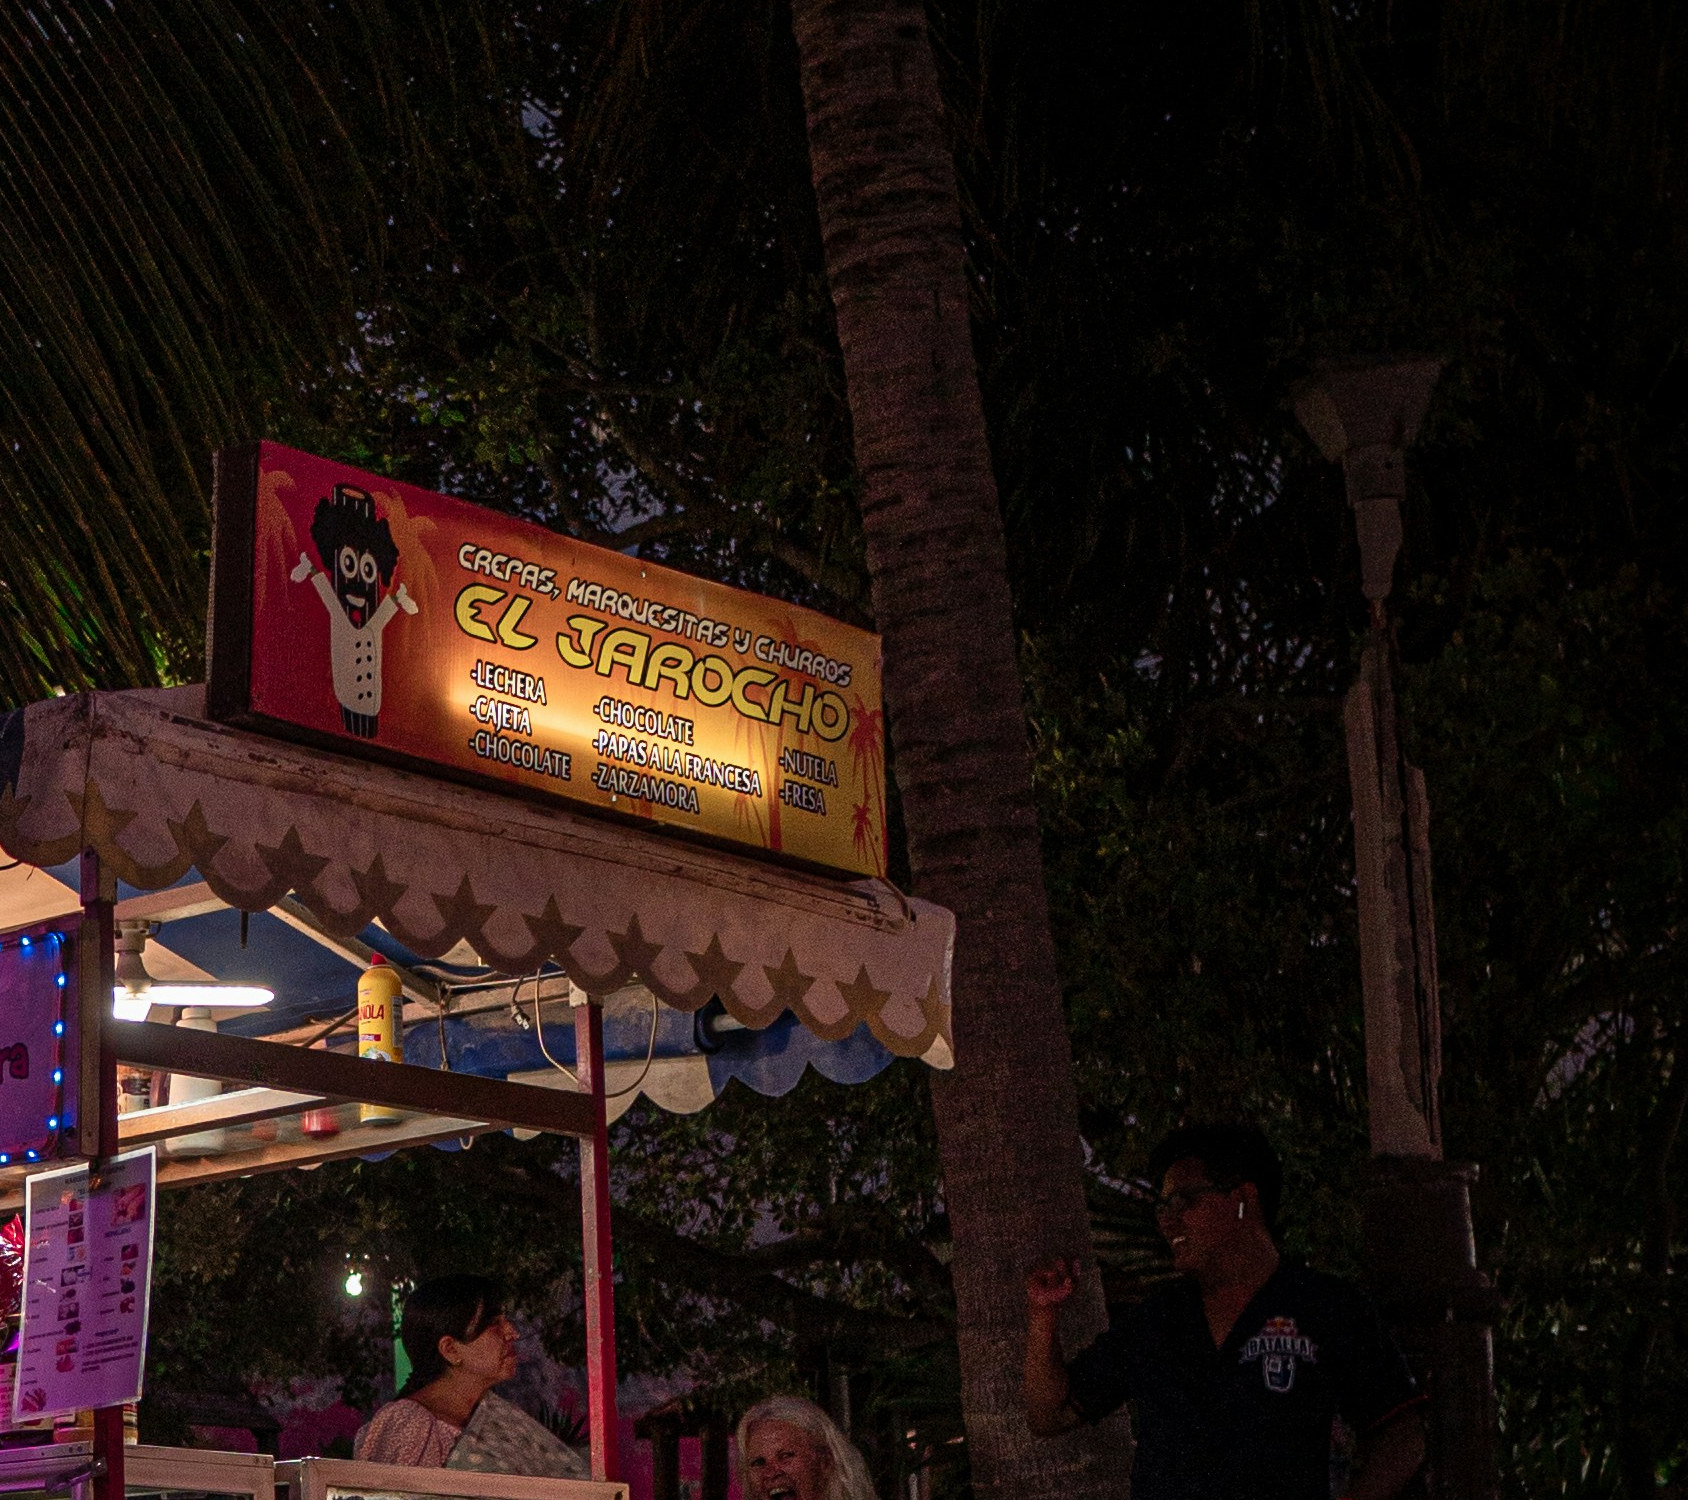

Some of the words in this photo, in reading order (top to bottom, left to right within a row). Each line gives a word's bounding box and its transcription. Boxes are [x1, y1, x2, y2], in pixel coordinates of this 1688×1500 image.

[454, 582, 538, 651] EL
[556, 614, 850, 743] JAROCHO
[458, 542, 561, 599] CREPAS,
[566, 578, 730, 647] MARQUESITAS
[734, 627, 751, 654] Y
[755, 636, 852, 687] CHURROS
[649, 744, 662, 771] A
[663, 747, 684, 777] LA
[684, 752, 762, 797] FRANCESA
